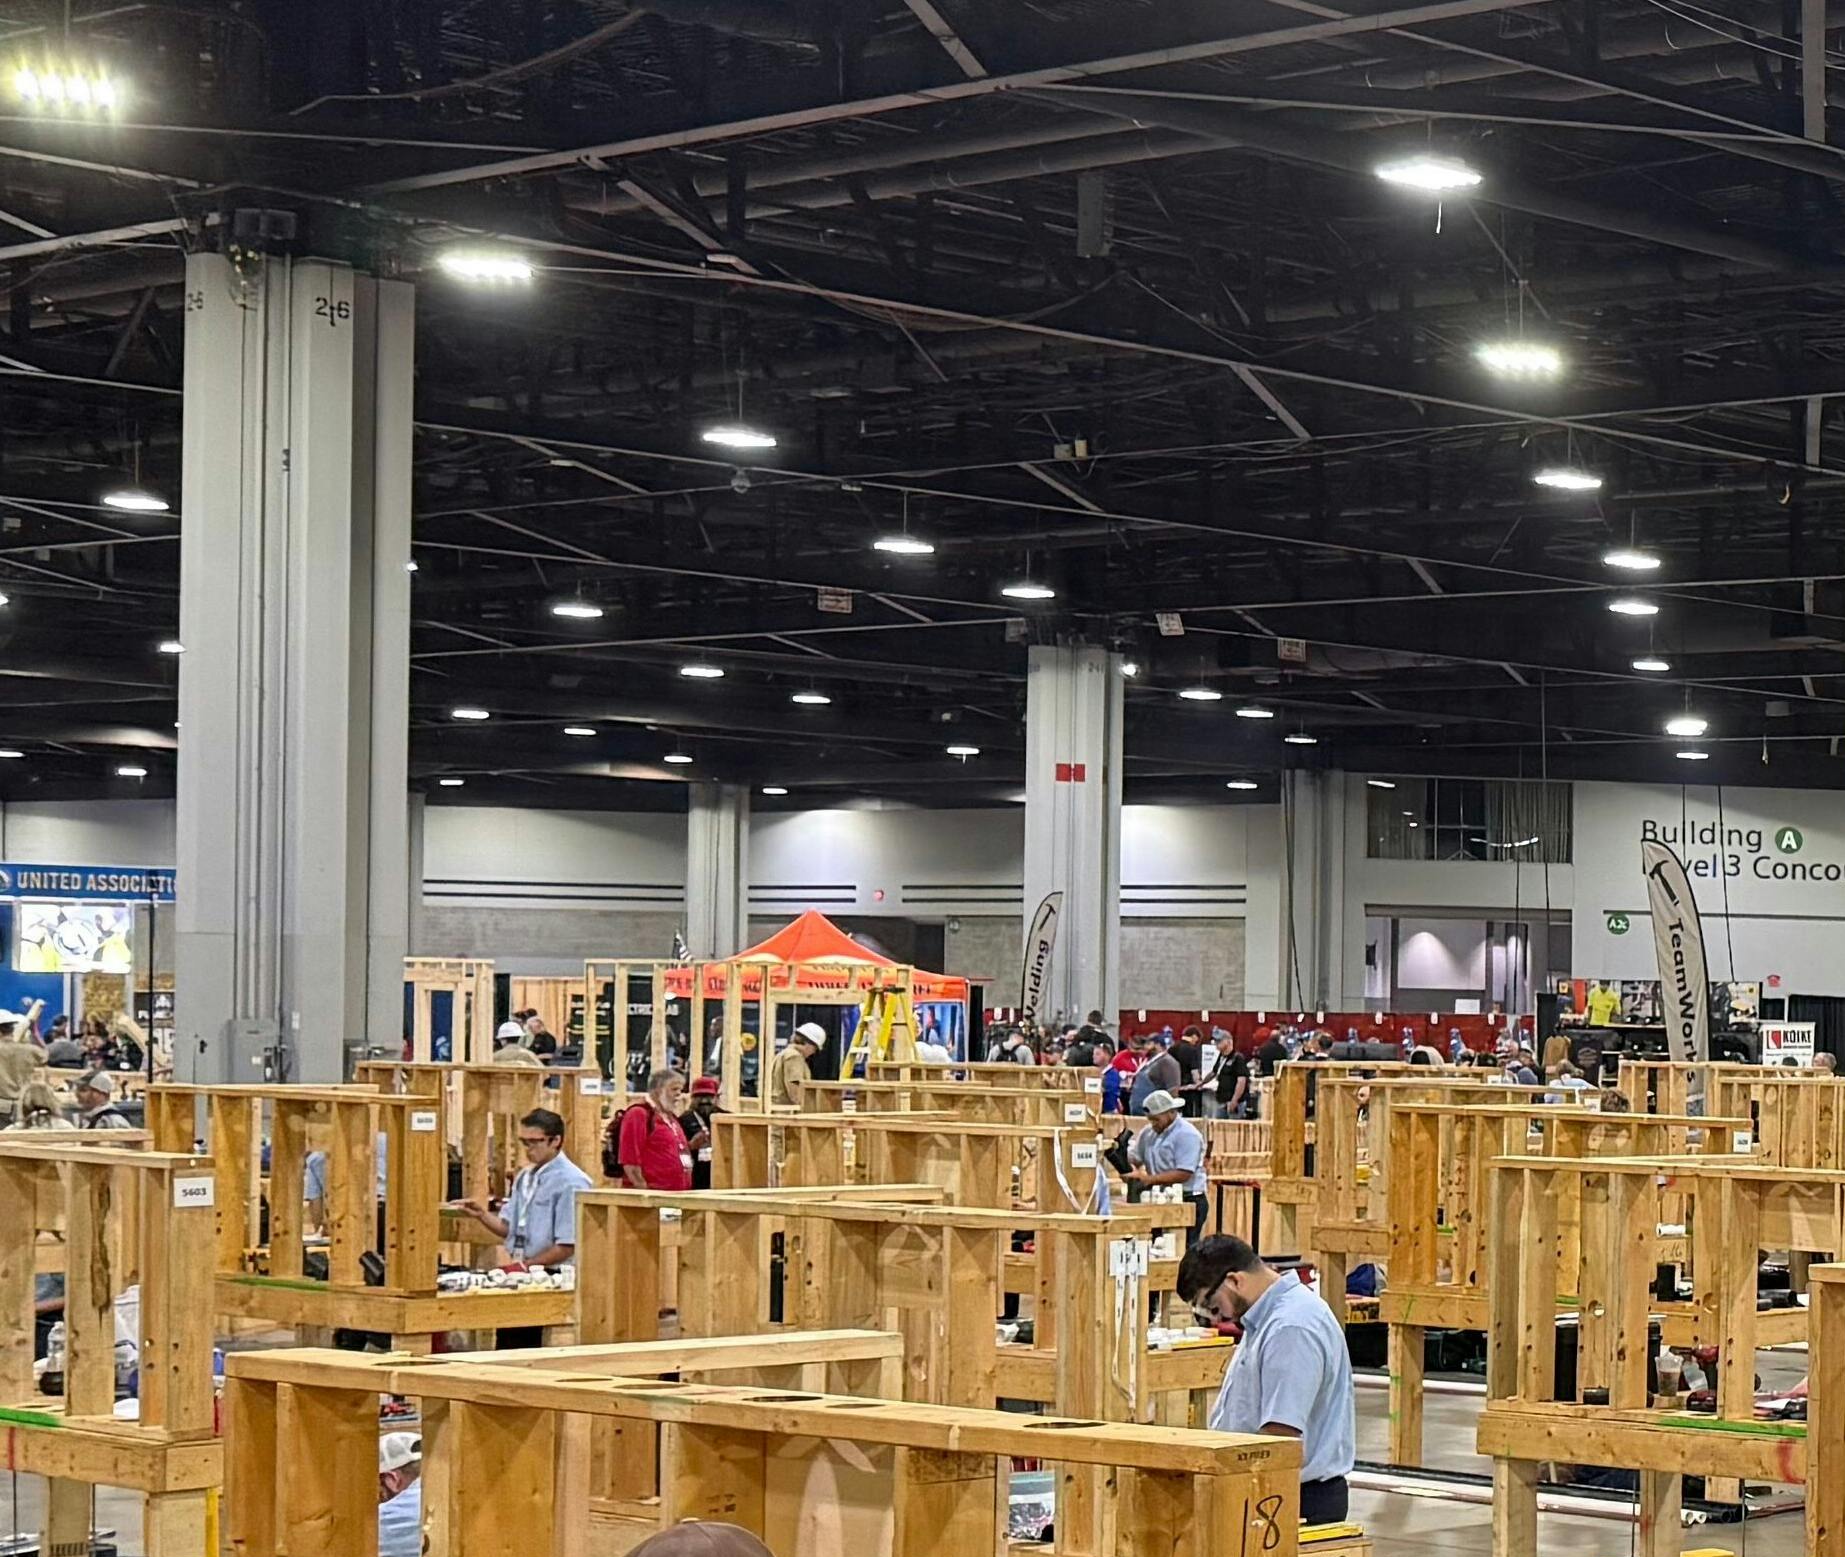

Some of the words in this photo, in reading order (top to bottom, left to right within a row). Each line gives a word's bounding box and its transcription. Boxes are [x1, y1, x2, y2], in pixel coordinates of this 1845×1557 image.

[1642, 821, 1762, 851] Building
[1782, 832, 1798, 849] A
[1723, 855, 1741, 877] 3
[17, 872, 81, 889] UNITED
[86, 874, 176, 894] ASSOCITI
[1023, 940, 1049, 1022] Welding
[182, 1187, 207, 1197] 5603
